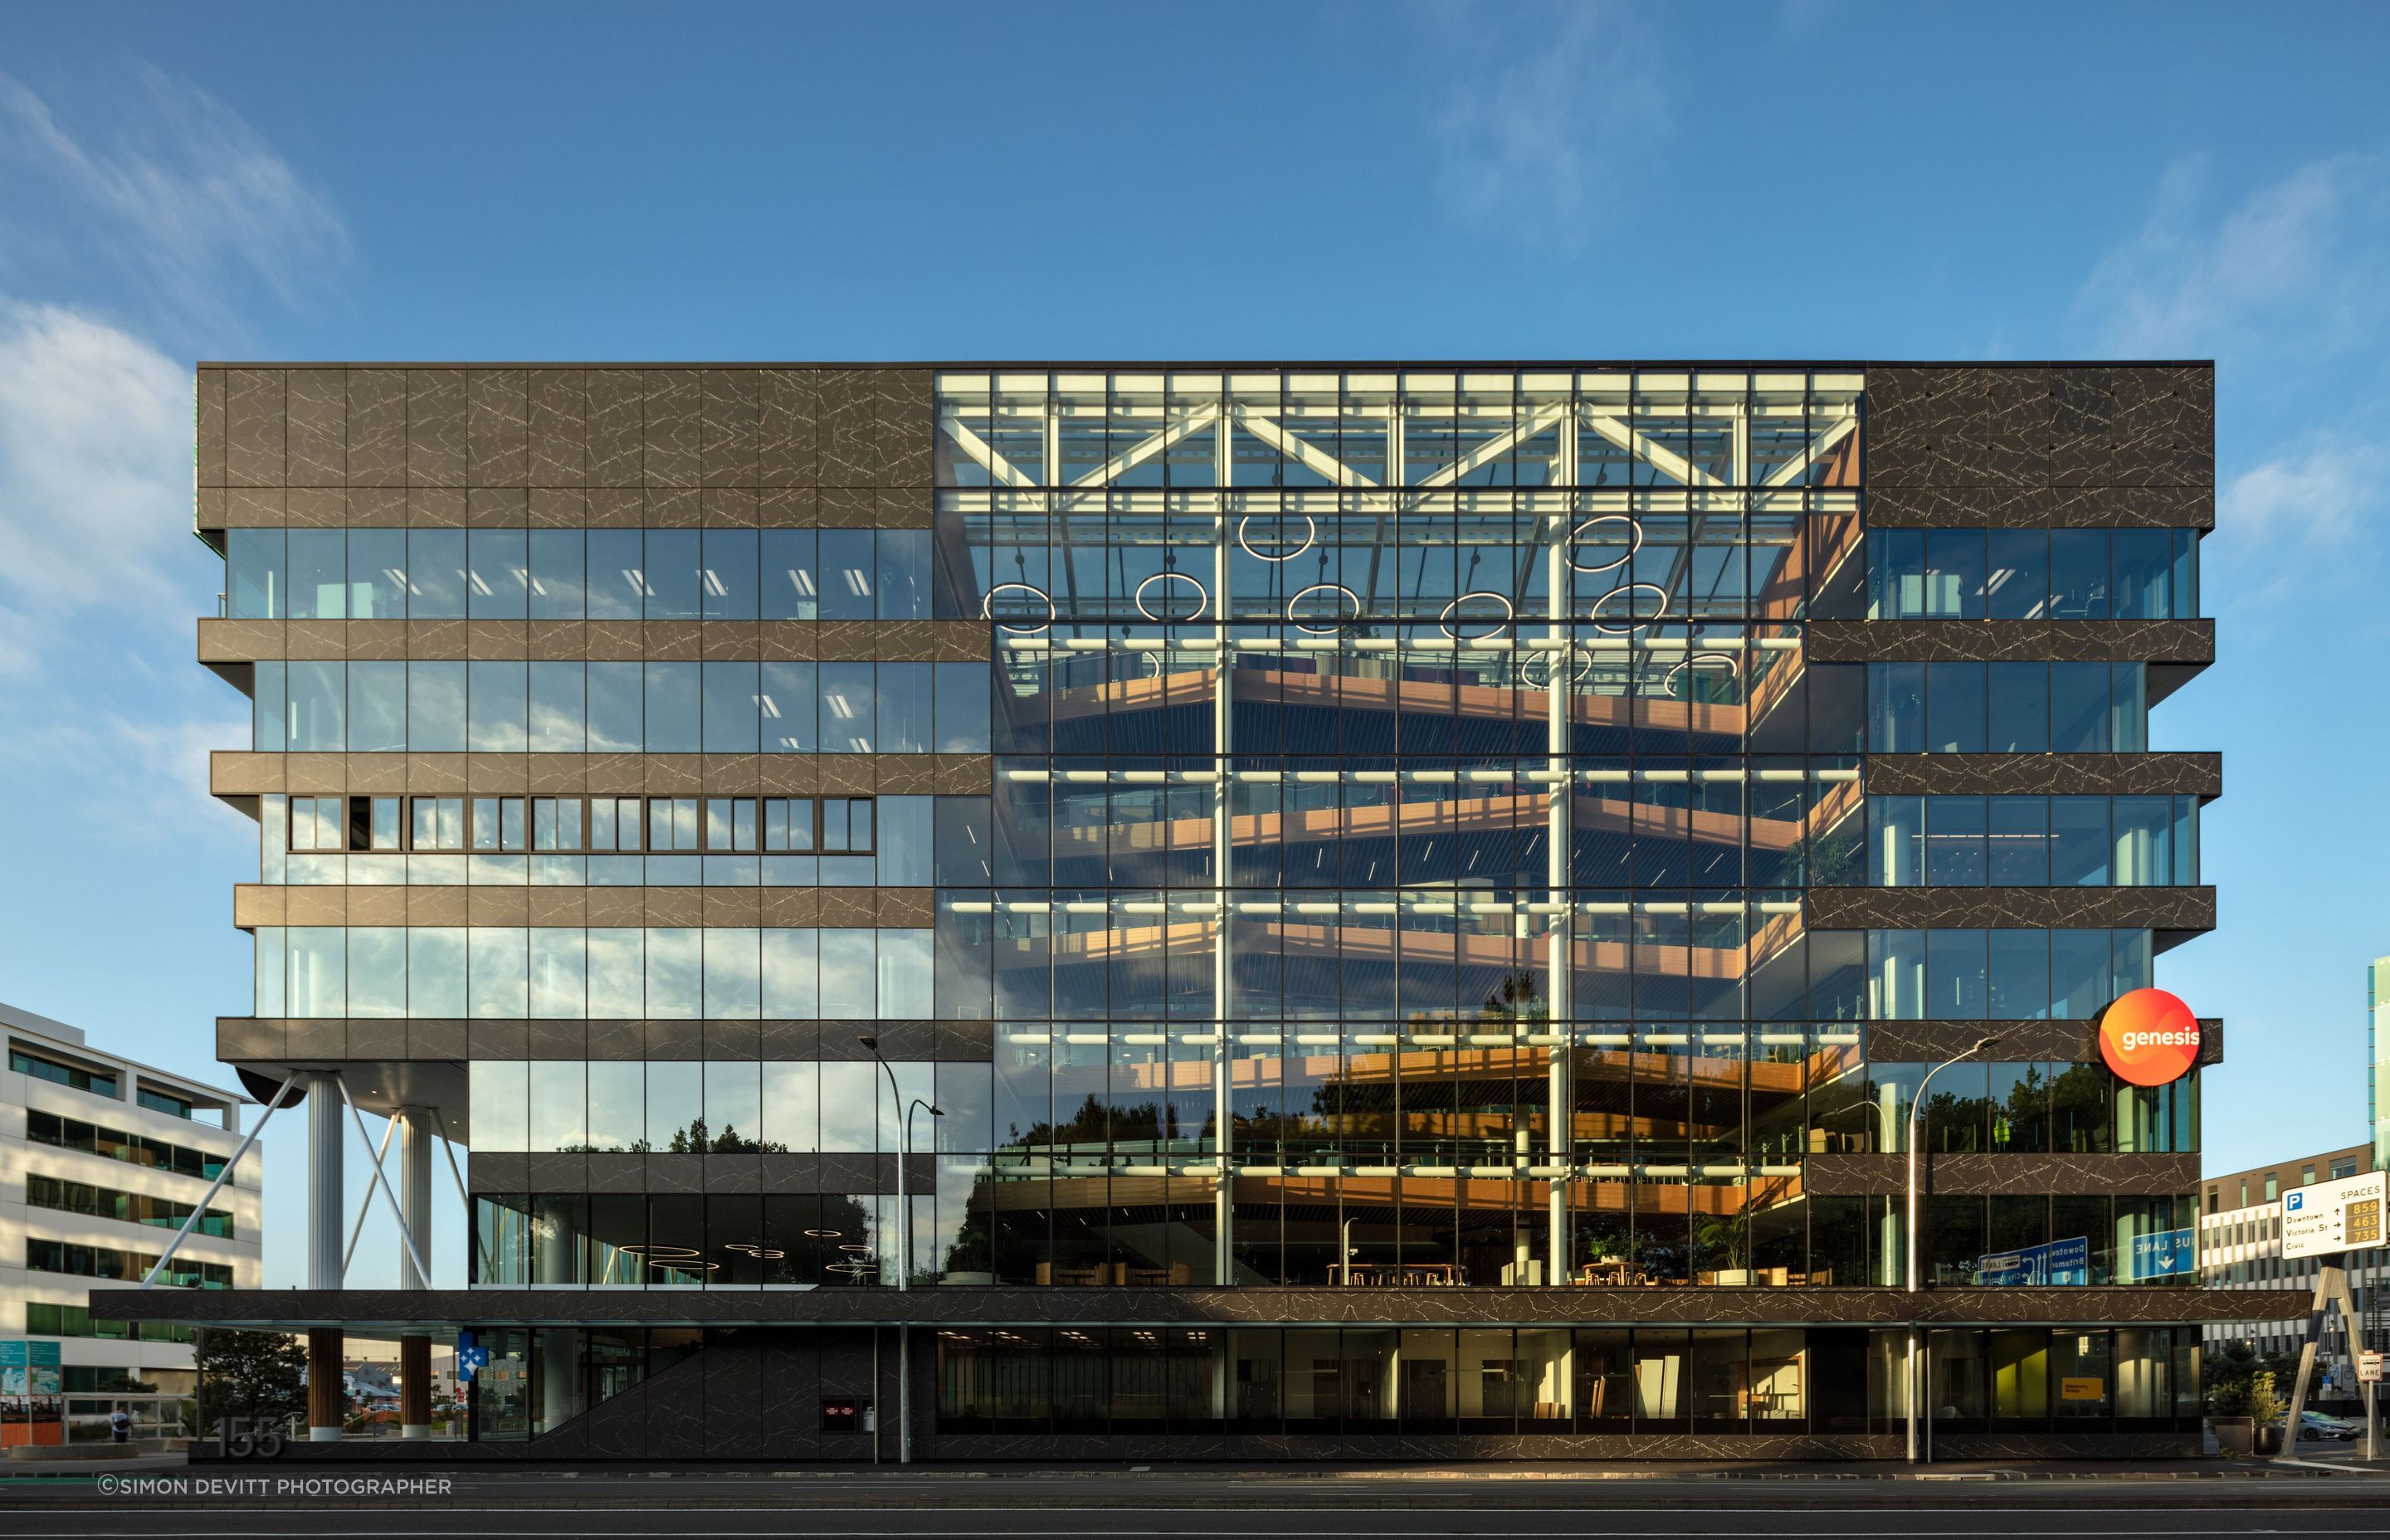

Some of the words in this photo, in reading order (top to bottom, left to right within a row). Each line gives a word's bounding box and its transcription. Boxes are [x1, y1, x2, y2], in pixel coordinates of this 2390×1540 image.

[2122, 1026, 2200, 1051] genesis
[2340, 1185, 2380, 1200] SPACES
[2289, 1195, 2300, 1209] P
[2353, 1201, 2378, 1215] 859
[2286, 1213, 2324, 1224] Downtown
[2353, 1215, 2378, 1228] 463
[2286, 1229, 2314, 1237] Victoria
[2319, 1224, 2328, 1232] St
[2354, 1229, 2378, 1242] 735
[212, 1416, 281, 1458] 155
